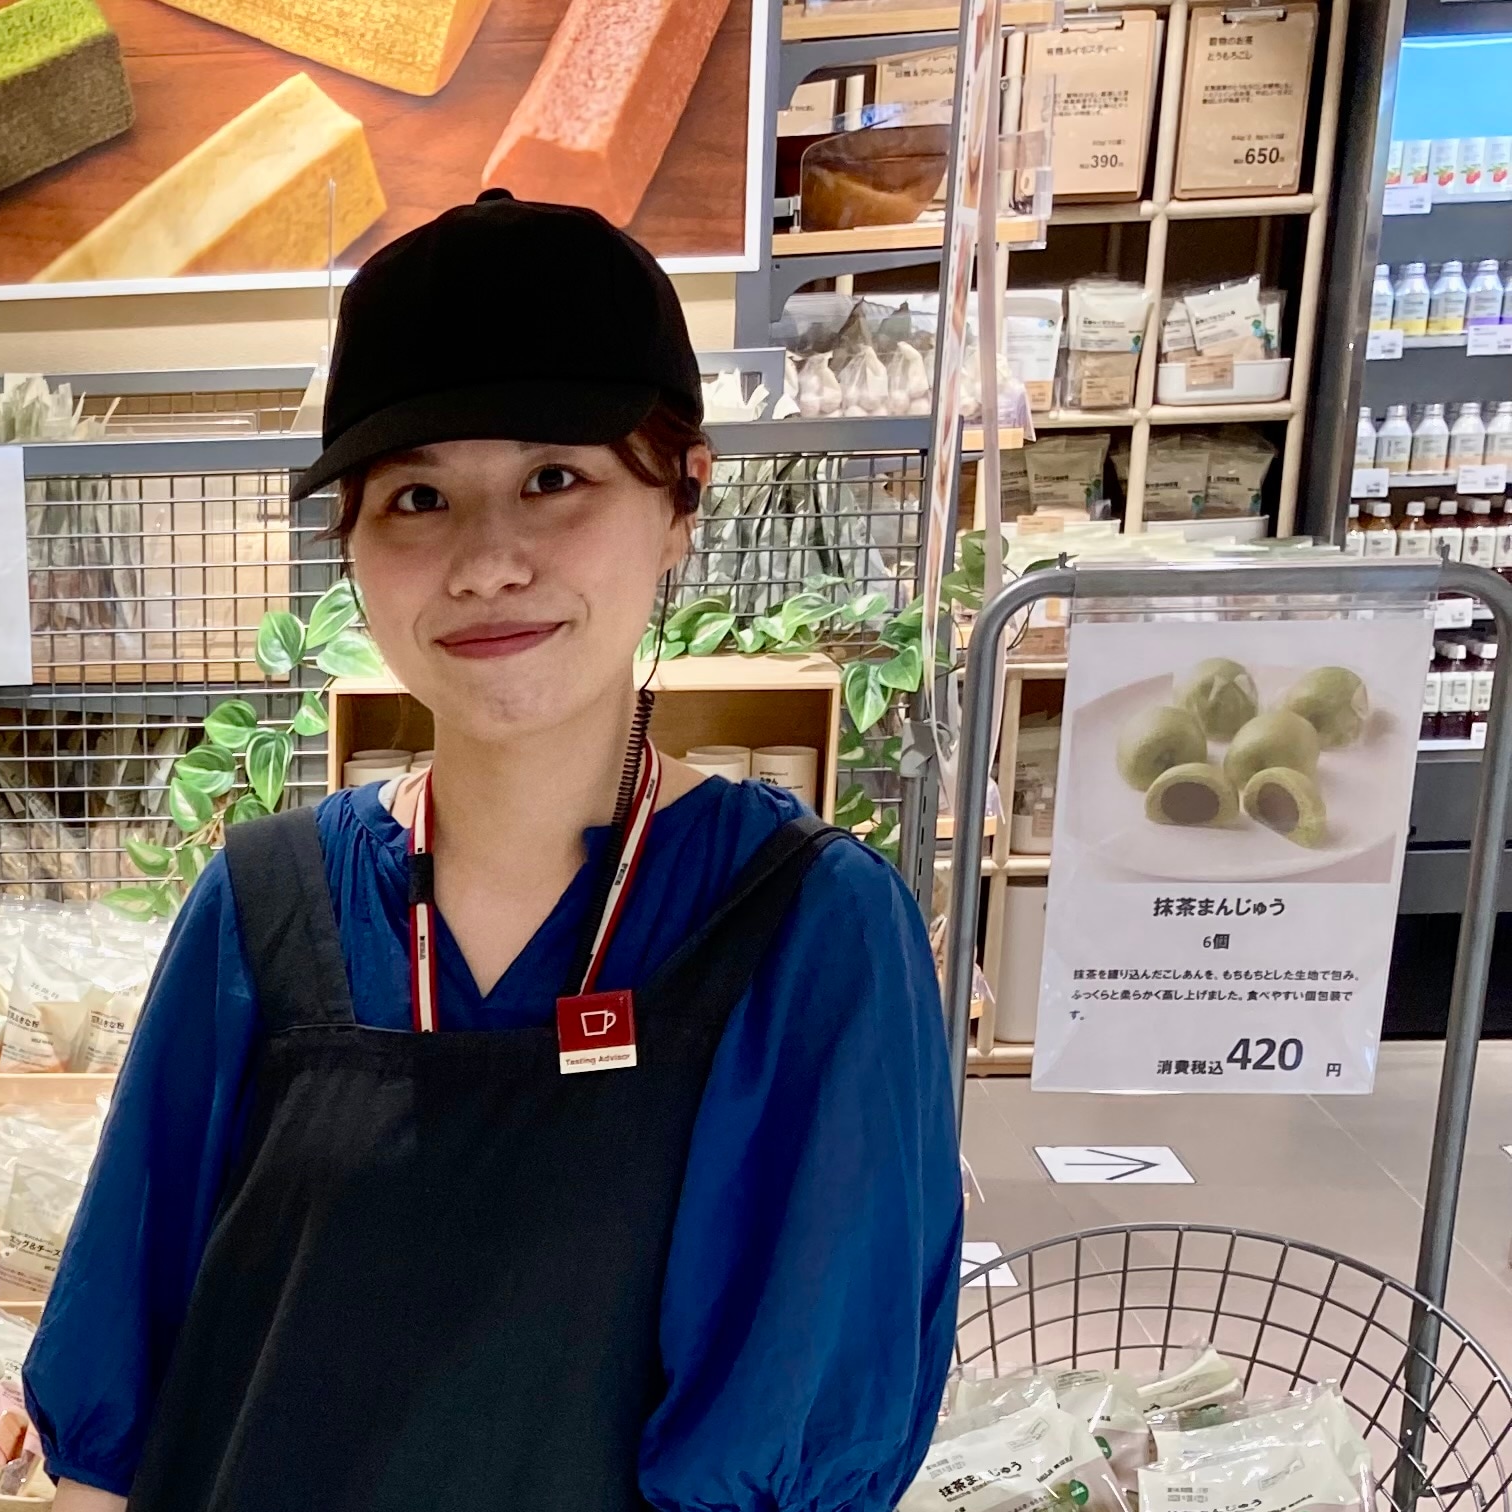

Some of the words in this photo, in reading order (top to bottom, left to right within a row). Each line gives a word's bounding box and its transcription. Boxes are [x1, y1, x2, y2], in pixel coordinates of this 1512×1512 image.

[1090, 154, 1118, 168] 390
[1245, 147, 1280, 165] 650
[1153, 896, 1286, 919] 抹茶まんじゅう
[1202, 932, 1230, 950] 6個
[1326, 1062, 1342, 1077] 円
[939, 1461, 1023, 1499] 抹茶まじゅう
